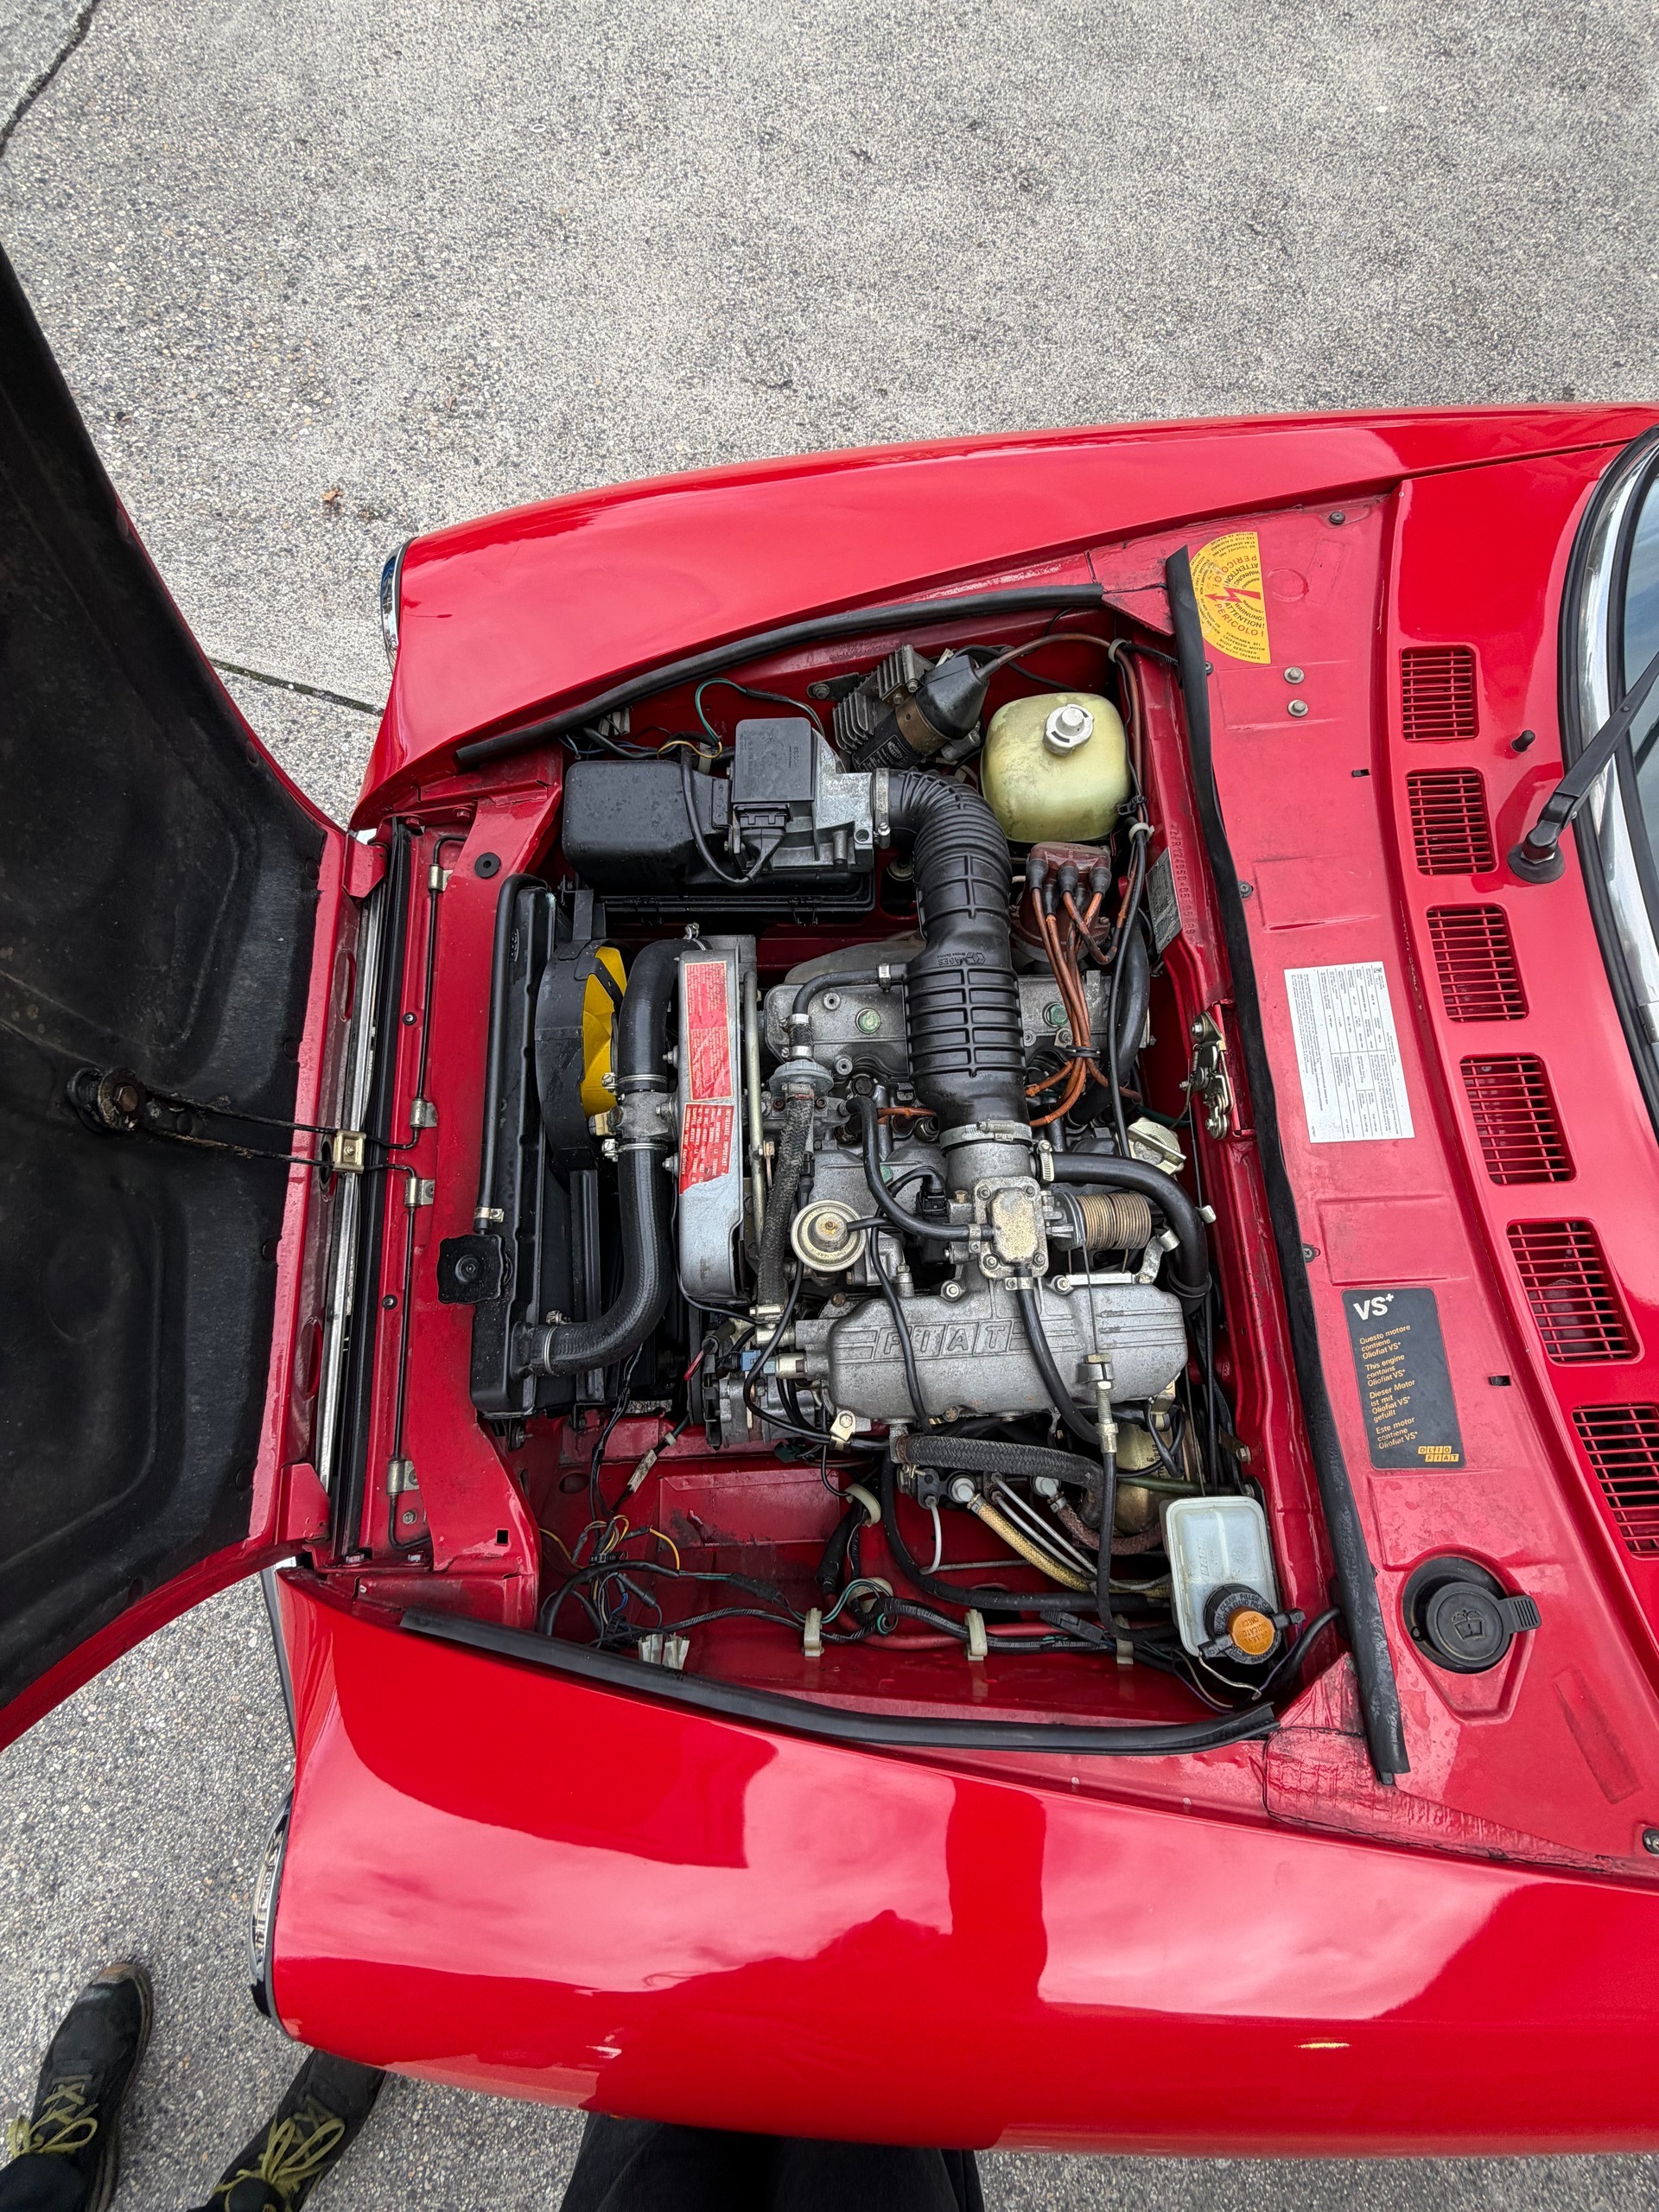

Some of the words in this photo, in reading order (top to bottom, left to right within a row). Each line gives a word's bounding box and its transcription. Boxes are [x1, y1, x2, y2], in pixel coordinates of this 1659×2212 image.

[1215, 603, 1258, 636] PERICOLO
[1224, 602, 1265, 629] ATTENTION!
[1235, 602, 1264, 621] WARNUNG!
[1353, 1294, 1394, 1320] VS+
[883, 1325, 1005, 1354] FIAT
[1359, 1332, 1383, 1344] Questo
[1385, 1325, 1410, 1337] motore
[1361, 1338, 1390, 1352] contiene
[1363, 1347, 1388, 1360] Oliofiat
[1388, 1342, 1402, 1351] VS+
[1365, 1363, 1381, 1371] This
[1382, 1354, 1405, 1367] engine
[1366, 1365, 1395, 1379] contains
[1368, 1376, 1393, 1387] Oliofiat
[1392, 1369, 1406, 1379] VS+
[1369, 1388, 1392, 1399] Dieser
[1394, 1380, 1415, 1391] Motor
[1372, 1402, 1397, 1414] Oliofiat
[1397, 1396, 1411, 1406] VS+
[1381, 1395, 1394, 1404] mit
[1376, 1426, 1391, 1434] Este
[1393, 1417, 1415, 1429] motor
[1377, 1427, 1408, 1442] contiene
[1378, 1438, 1404, 1450] Oliofiat
